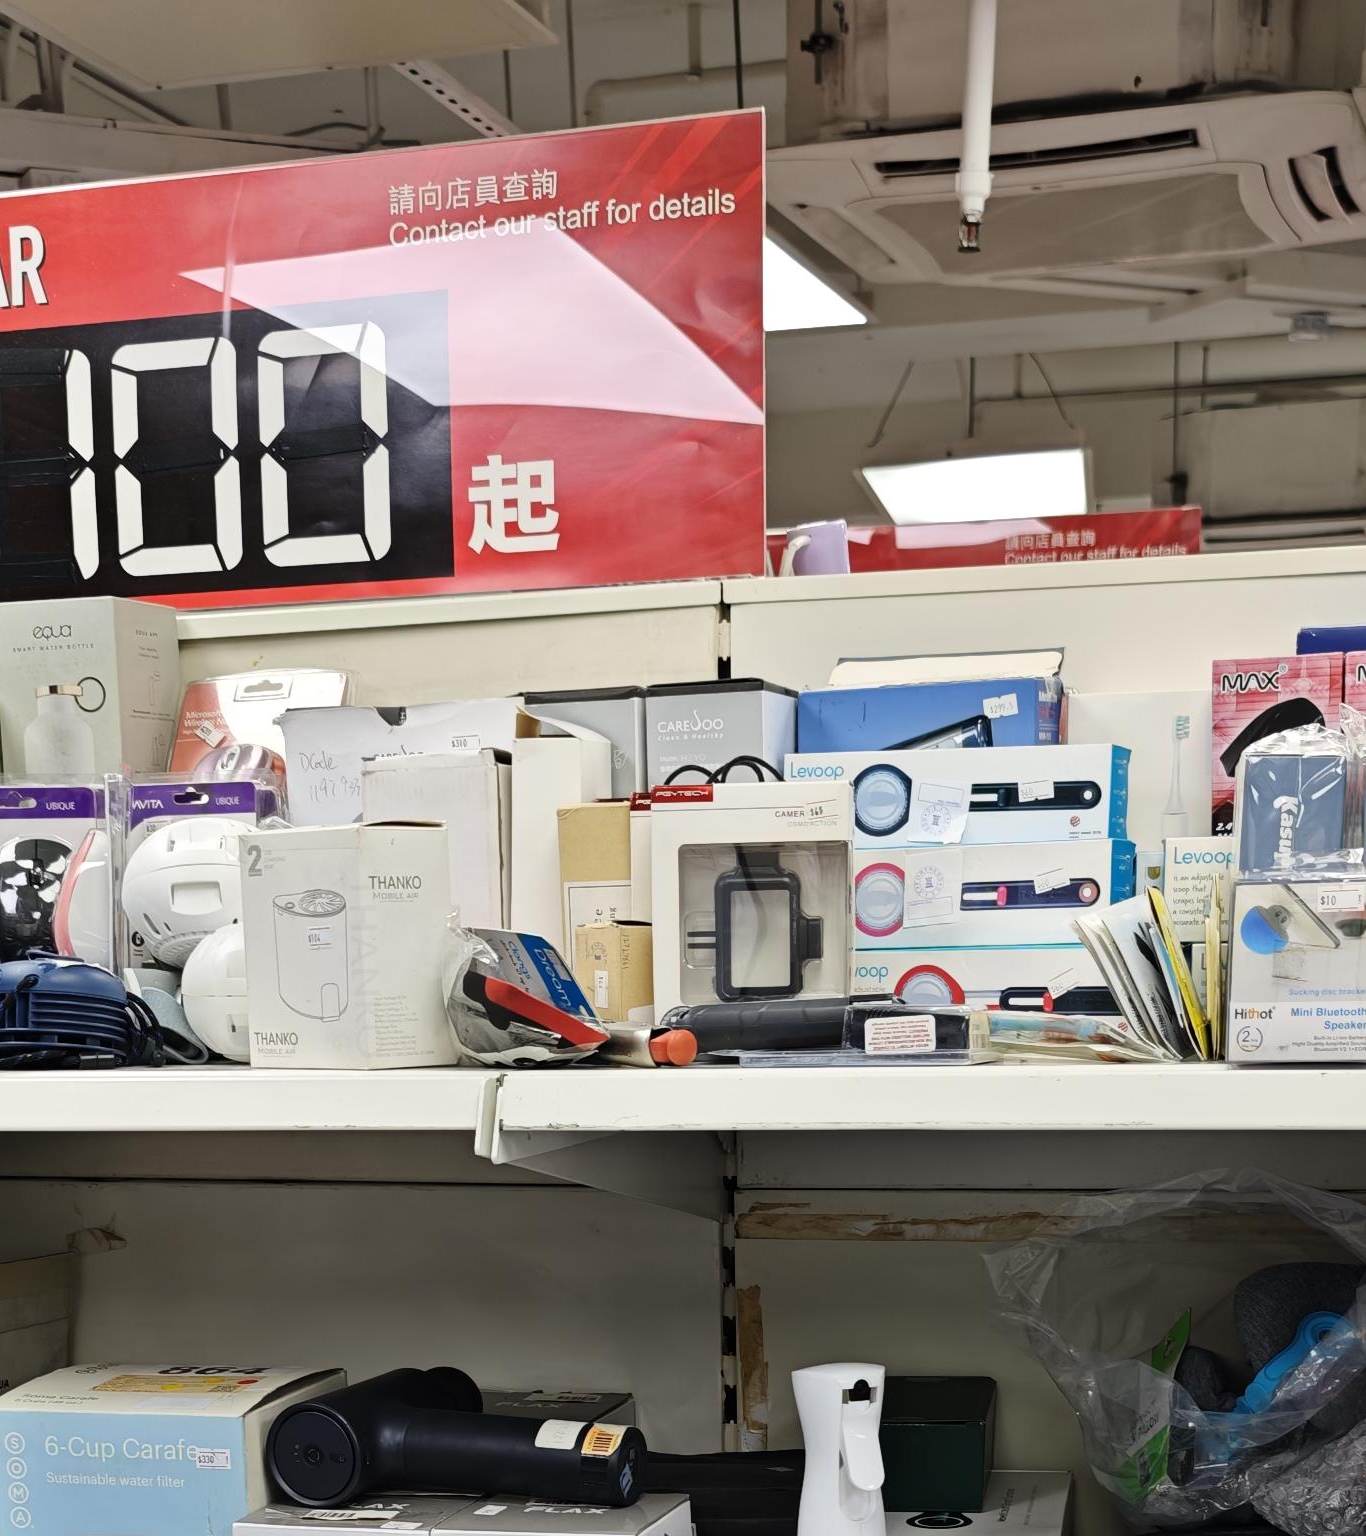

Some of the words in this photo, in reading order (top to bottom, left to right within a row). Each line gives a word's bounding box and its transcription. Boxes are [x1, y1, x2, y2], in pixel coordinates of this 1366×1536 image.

[388, 169, 558, 215] 請向店員查詢
[389, 216, 486, 247] Contact
[494, 215, 535, 236] our
[544, 201, 600, 231] staff
[606, 201, 641, 225] for
[649, 188, 736, 222] details
[467, 455, 562, 555] 起
[33, 623, 72, 641] equa
[1221, 673, 1280, 692] MAX
[791, 762, 844, 780] Levoop
[45, 800, 75, 811] UBIQUE
[247, 845, 263, 876] 2
[369, 875, 422, 890] THANKO
[1319, 895, 1337, 906] $10
[1234, 1006, 1274, 1020] Hithot
[1290, 1008, 1311, 1017] Mini
[254, 1032, 299, 1046] THANKO
[45, 1436, 115, 1462] 6-Cup
[122, 1436, 199, 1460] Carafe
[197, 1454, 215, 1465] $330
[45, 1473, 115, 1487] Sustainable
[119, 1475, 153, 1487] water
[156, 1475, 185, 1489] filter
